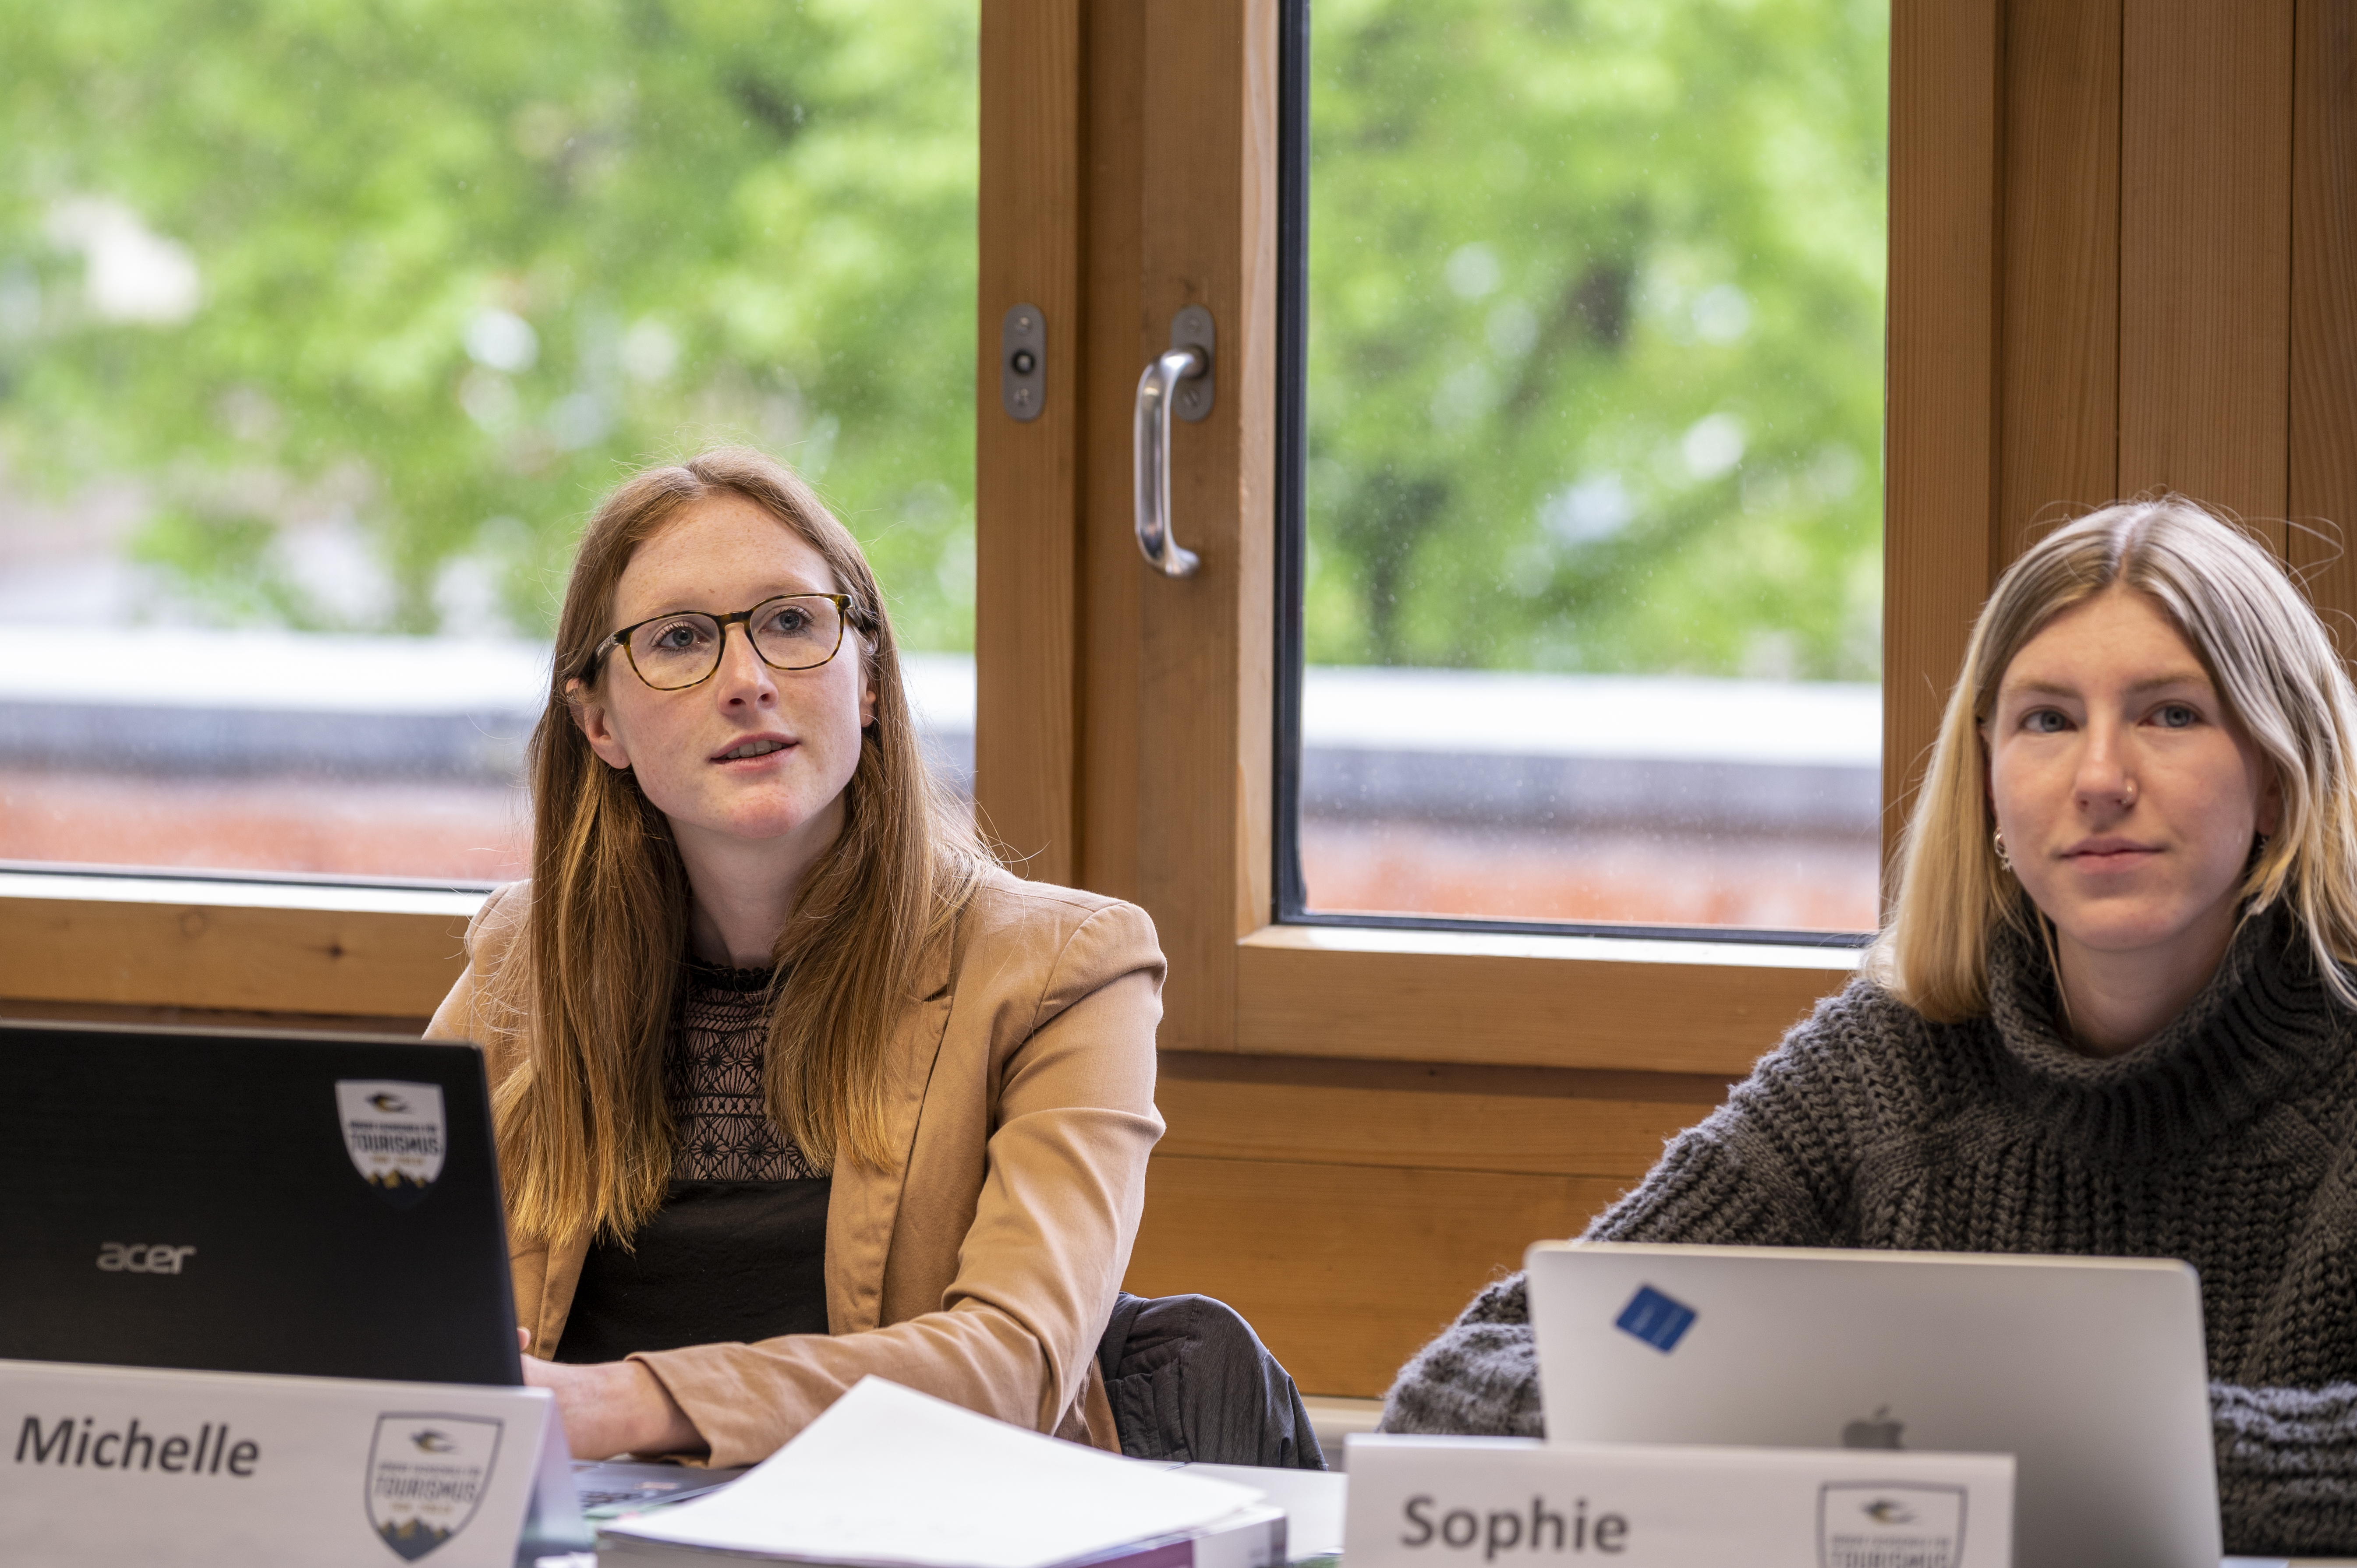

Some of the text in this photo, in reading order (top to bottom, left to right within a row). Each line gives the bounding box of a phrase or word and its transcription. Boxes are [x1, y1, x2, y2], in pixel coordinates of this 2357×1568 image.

[96, 1242, 196, 1274] acer
[15, 1415, 259, 1478] Michelle
[1402, 1495, 1627, 1561] Sophie
